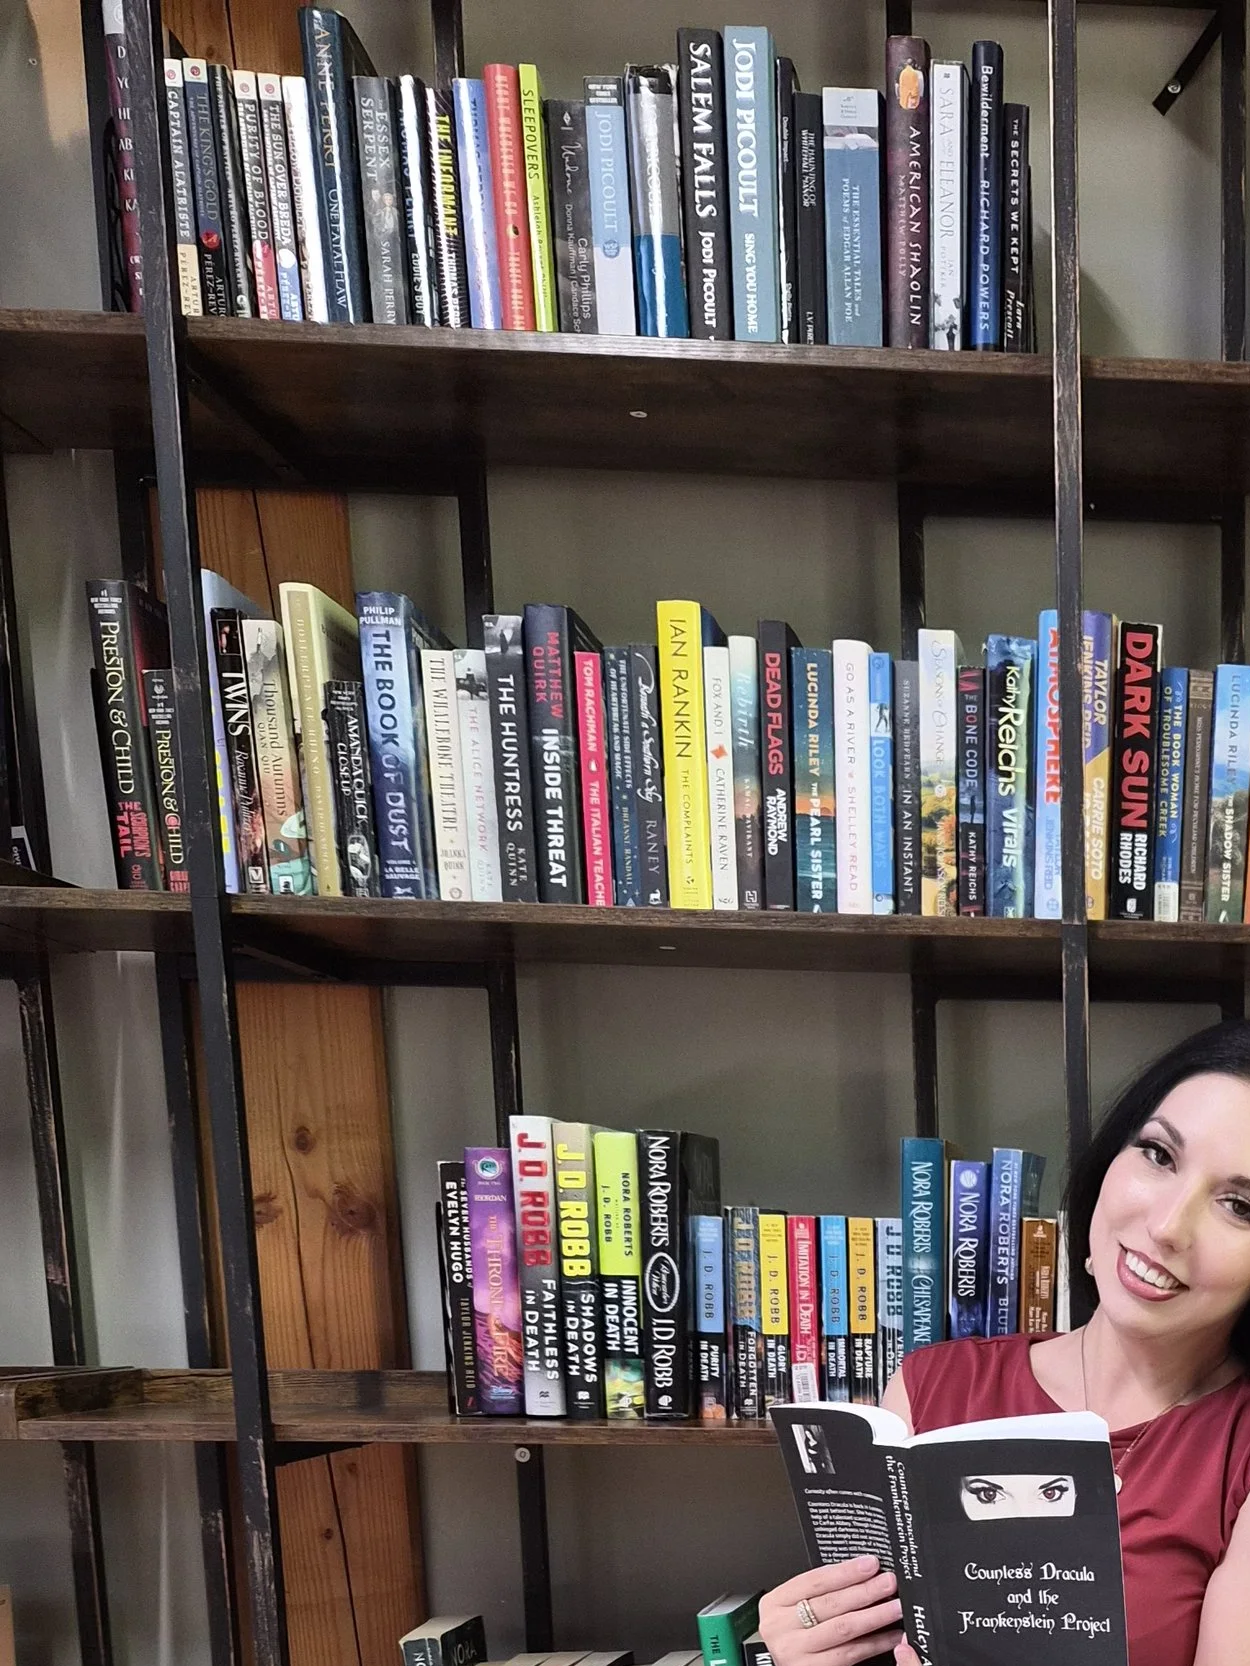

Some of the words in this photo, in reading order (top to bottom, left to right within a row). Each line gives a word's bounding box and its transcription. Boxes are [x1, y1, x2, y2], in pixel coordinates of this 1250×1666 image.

[689, 42, 714, 135] SALEM
[733, 38, 756, 108] JODI
[168, 90, 183, 155] CAPTAIN
[248, 103, 259, 162] PURITY
[271, 105, 281, 127] THE
[361, 97, 378, 181] SERPENT
[375, 109, 391, 169] ESSEX
[522, 89, 540, 181] SLEEPOVERS
[980, 66, 993, 158] Bewilderment
[273, 129, 284, 159] SUN
[737, 112, 760, 217] PICOULT
[173, 159, 190, 238] ALATRISTE
[252, 166, 262, 187] OF
[277, 163, 287, 199] OVER
[694, 143, 717, 218] FALLS
[909, 126, 922, 234] AMERICAN
[255, 191, 268, 240] BLOOD
[280, 202, 292, 245] BREDA
[980, 180, 992, 256] RICHARD
[380, 240, 392, 284] SARAH
[699, 230, 715, 264] JODI
[744, 233, 755, 261] SING
[744, 262, 757, 288] YOU
[384, 288, 397, 326] PERRY
[701, 268, 717, 327] PICOULT
[746, 288, 758, 334] HOME
[909, 240, 922, 326] SHAOLIN
[980, 263, 991, 331] POWERS
[359, 616, 402, 626] PULLMAN
[670, 618, 688, 657] IAN
[100, 621, 126, 705] PRESTON
[372, 631, 393, 672] THE
[765, 652, 781, 709] DEAD
[222, 672, 250, 736] TWINS
[375, 678, 400, 746] BOOK
[497, 674, 516, 716] THE
[673, 669, 692, 759] RANKIN
[1124, 632, 1153, 739] DARK
[110, 709, 127, 727] &
[264, 680, 281, 756] Thousand
[767, 711, 783, 775] FLAGS
[112, 729, 135, 795] CHILD
[272, 760, 287, 817] Autumns
[500, 722, 523, 833] HUNTRESS
[542, 728, 562, 801] INSIDE
[1121, 749, 1148, 828] SUN
[386, 790, 412, 856] DUST
[682, 795, 693, 864] COMPLAINTS
[766, 796, 779, 856] RAYMOND
[775, 788, 787, 843] ANDREW
[506, 842, 517, 887] QUINN
[517, 848, 527, 882] KATE
[545, 807, 567, 887] THREAT
[1118, 833, 1133, 885] RHODES
[1132, 833, 1147, 891] RICHARD
[648, 1136, 670, 1182] NORA
[999, 1160, 1011, 1206] NORA
[445, 1181, 459, 1236] EVELYN
[650, 1181, 670, 1247] ROBERTS
[960, 1192, 980, 1232] NORA
[450, 1239, 463, 1283] HUGO
[954, 1238, 979, 1297] ROBERTS
[997, 1212, 1011, 1284] ROBERTS
[525, 1291, 538, 1304] IN
[565, 1301, 575, 1313] IN
[603, 1283, 617, 1302] IN
[621, 1279, 638, 1356] INNOCENT
[525, 1309, 539, 1373] DEATH
[541, 1279, 559, 1381] FAITHLESS
[565, 1316, 579, 1376] DEATH
[580, 1293, 597, 1383] SHADOWS
[605, 1305, 620, 1352] DEATH
[888, 1474, 908, 1543] Frankenstein
[900, 1546, 912, 1581] Project
[911, 1557, 921, 1578] and
[1039, 1561, 1095, 1581] Dracula
[1007, 1590, 1031, 1609] and
[710, 1635, 720, 1654] THE
[913, 1605, 929, 1656] Haley
